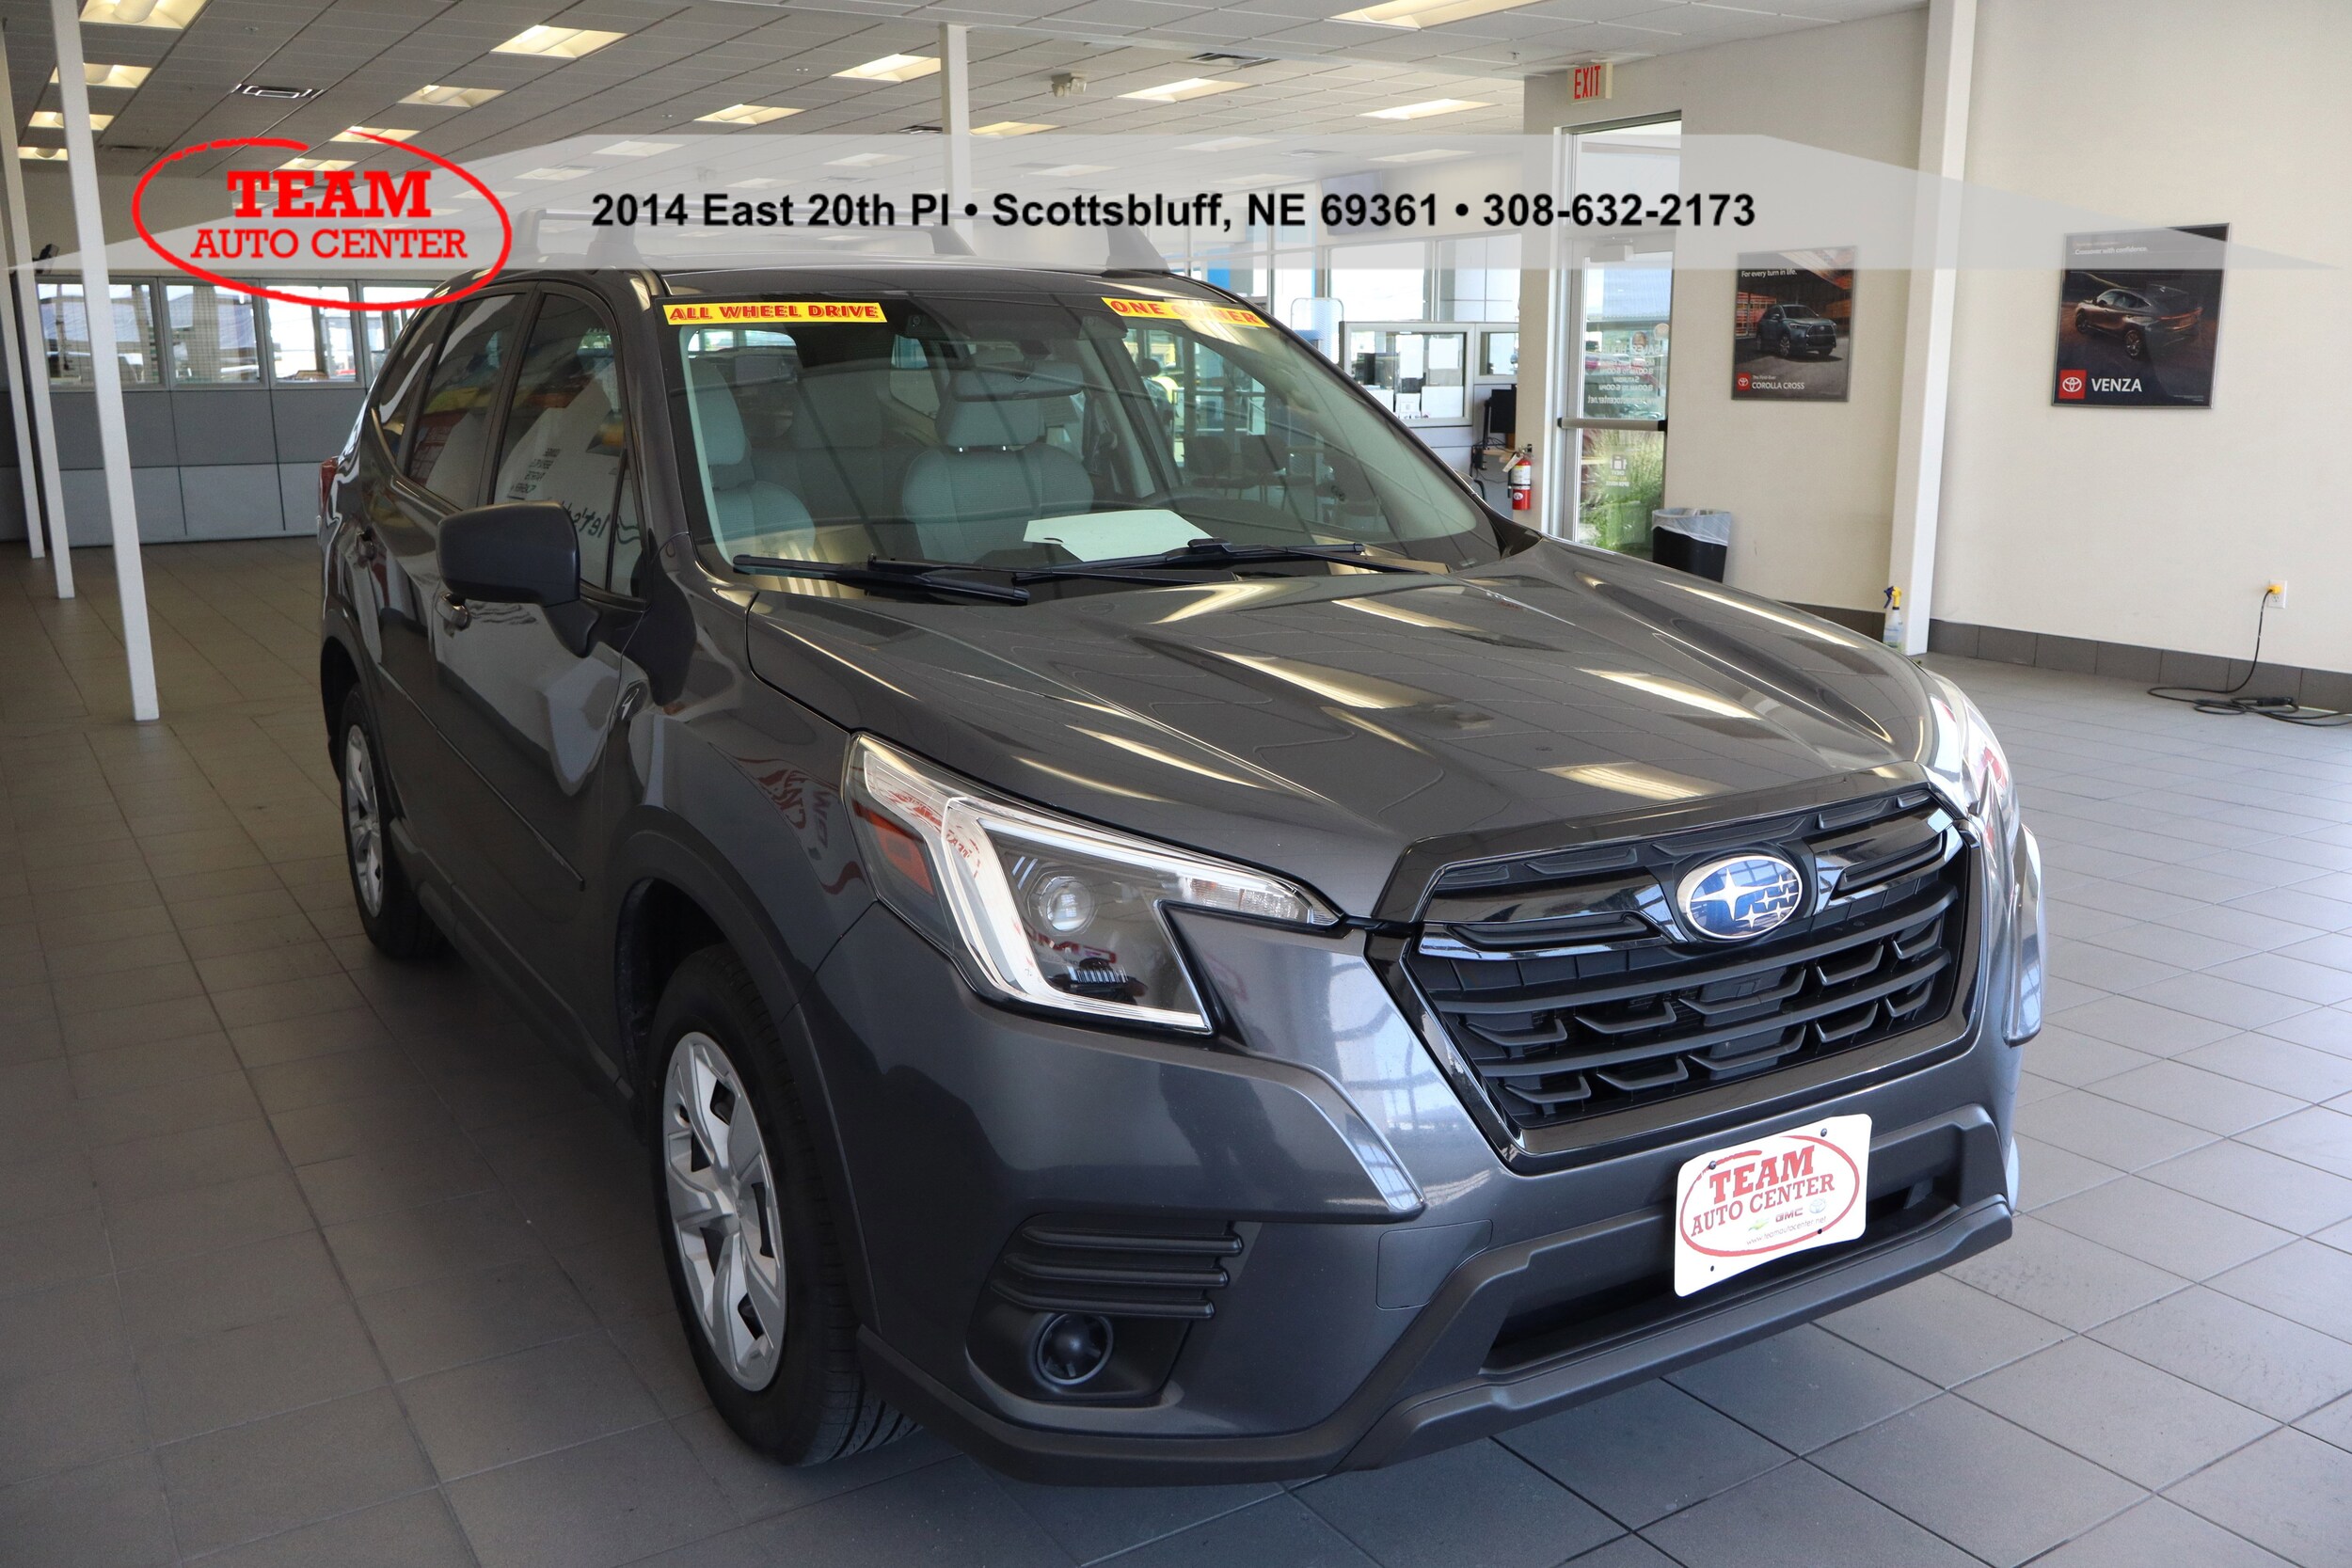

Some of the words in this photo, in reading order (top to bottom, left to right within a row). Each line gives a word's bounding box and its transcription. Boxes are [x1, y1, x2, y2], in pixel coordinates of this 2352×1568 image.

[1574, 65, 1601, 100] EXIT
[1786, 267, 1797, 276] life.
[670, 308, 712, 321] ALL
[719, 305, 801, 318] WHEEL
[808, 305, 880, 318] DRIVE
[1110, 300, 1165, 315] ONE
[1752, 381, 1782, 389] COROLLA
[1783, 381, 1805, 389] CROSS
[2090, 377, 2143, 392] VENZA
[1708, 1144, 1815, 1205] TEAM
[1690, 1200, 1743, 1237] AUTO
[1749, 1173, 1836, 1213] CENTER
[1775, 1207, 1804, 1223] GMC
